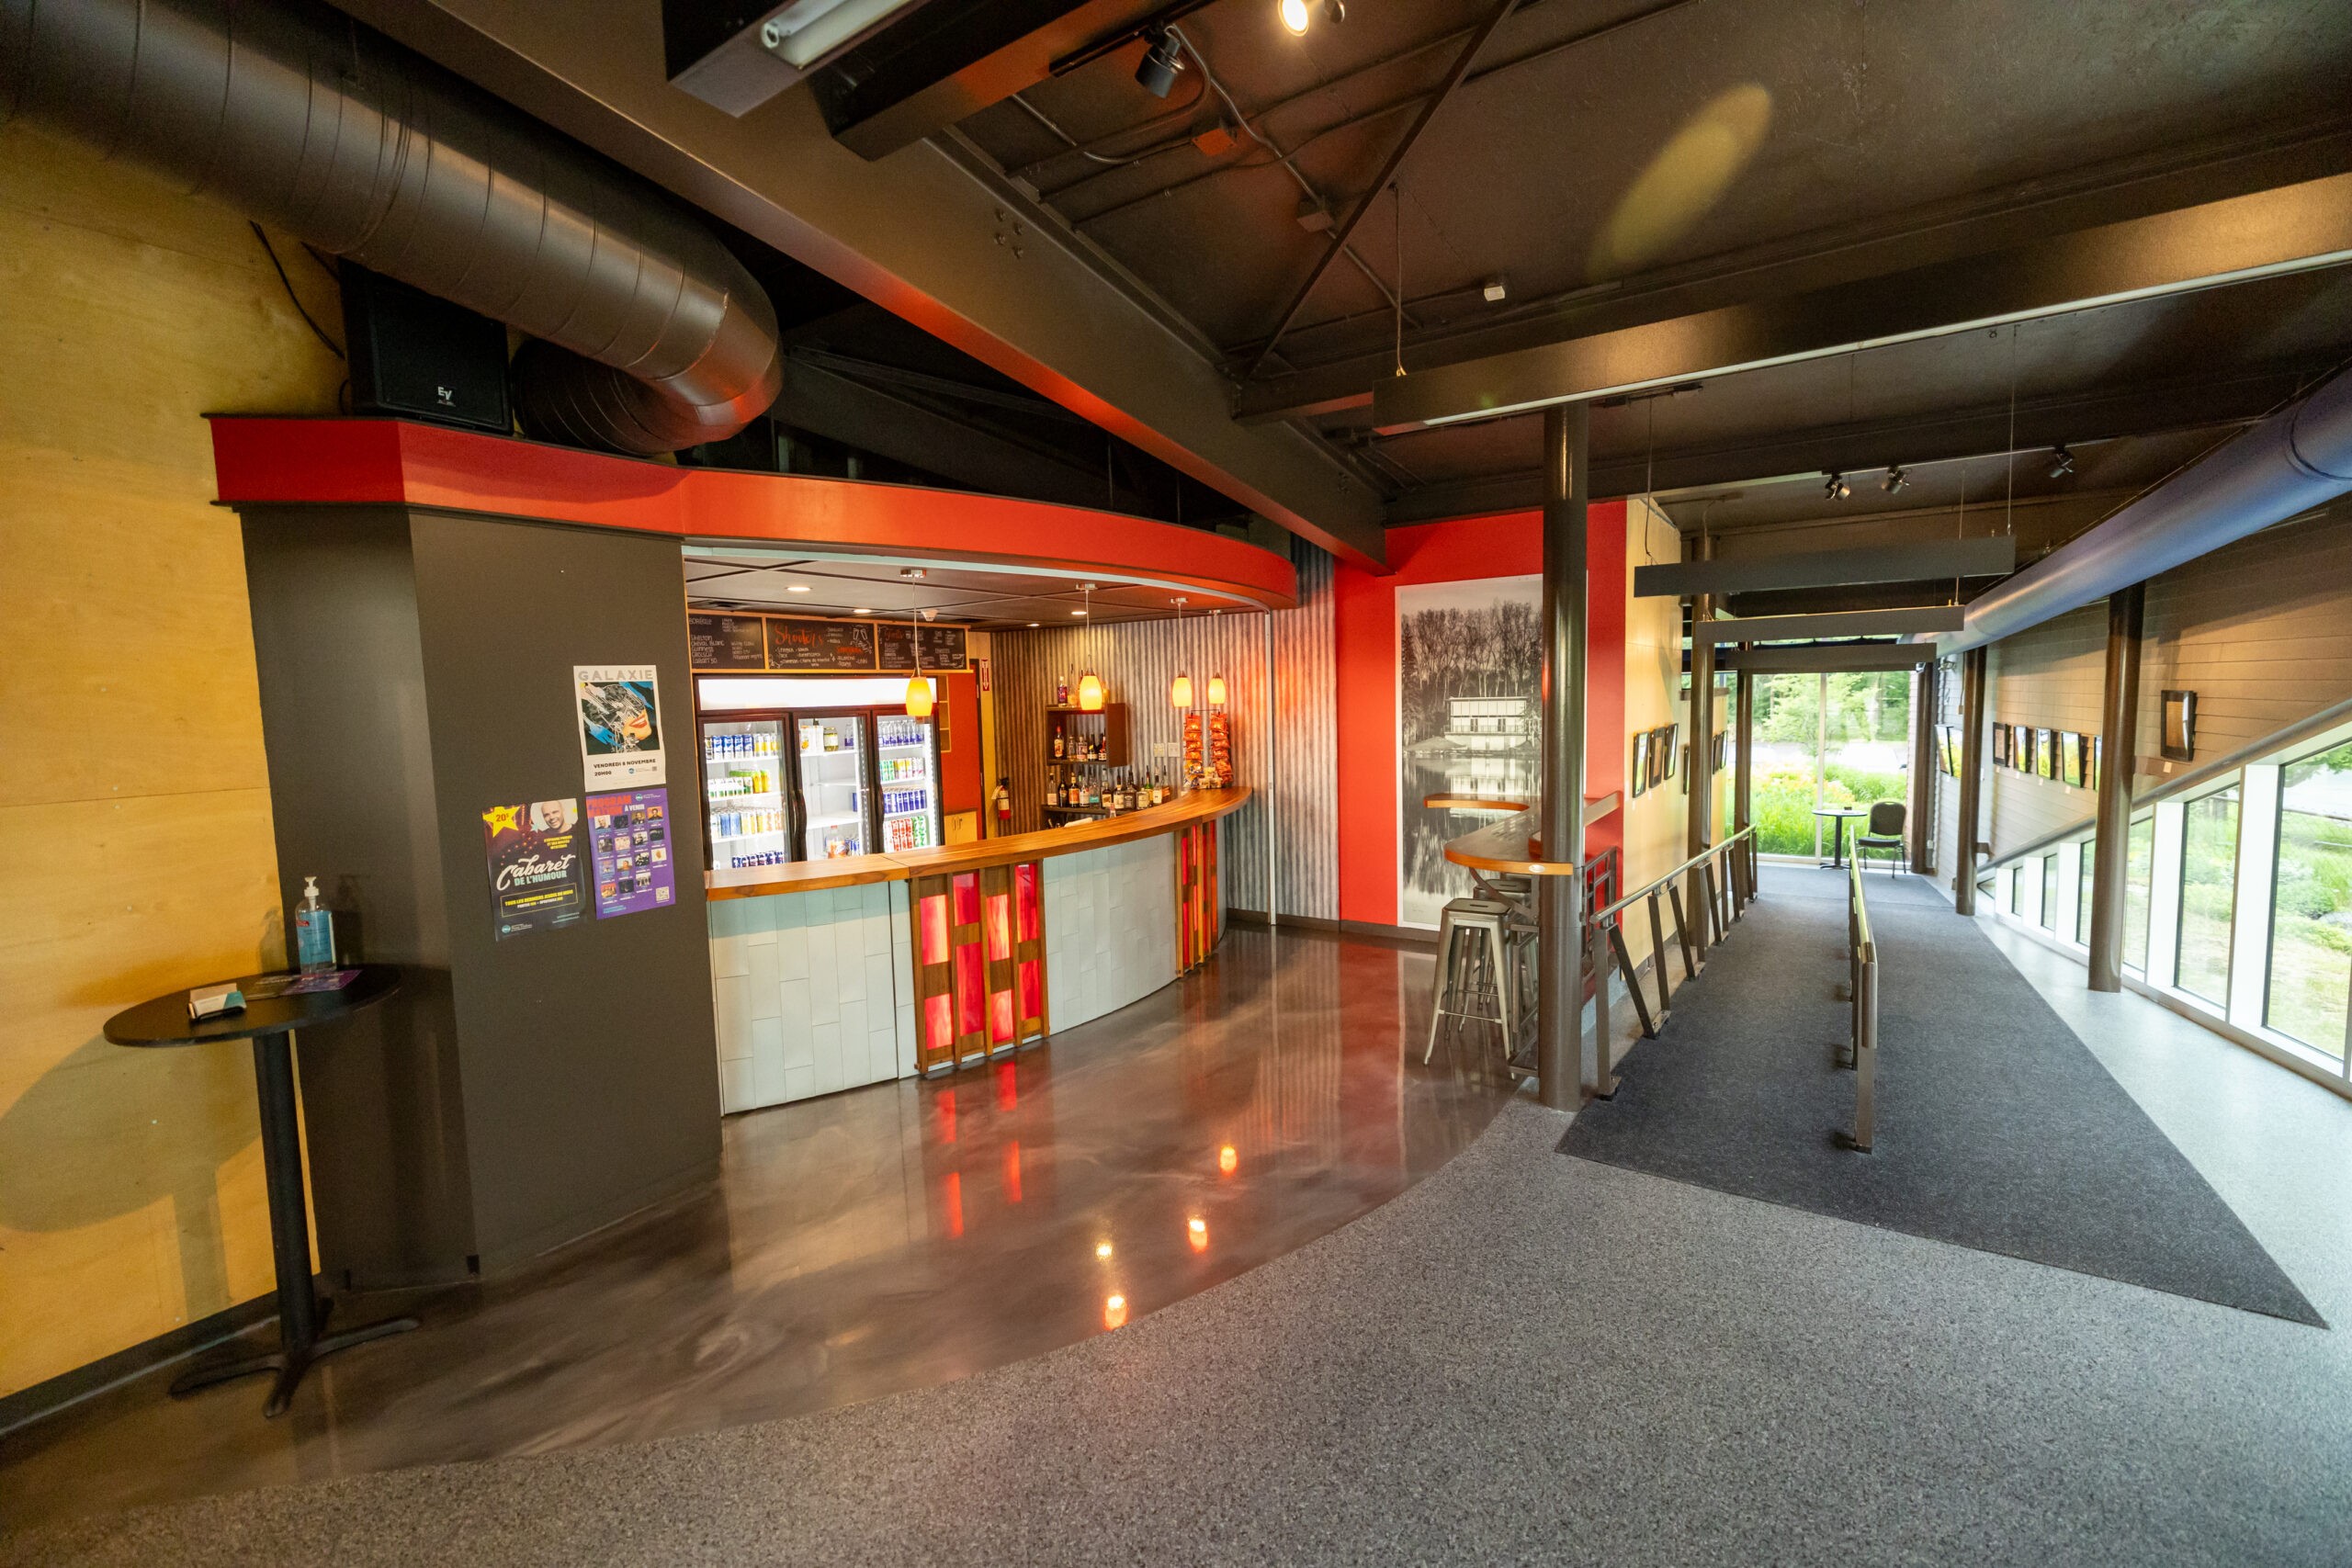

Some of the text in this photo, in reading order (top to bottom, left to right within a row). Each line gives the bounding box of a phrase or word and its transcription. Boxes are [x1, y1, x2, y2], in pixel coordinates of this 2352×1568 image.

[578, 670, 653, 681] GALAXIE
[497, 854, 576, 891] Cabaret
[514, 870, 568, 886] DE L'HUMOUR
